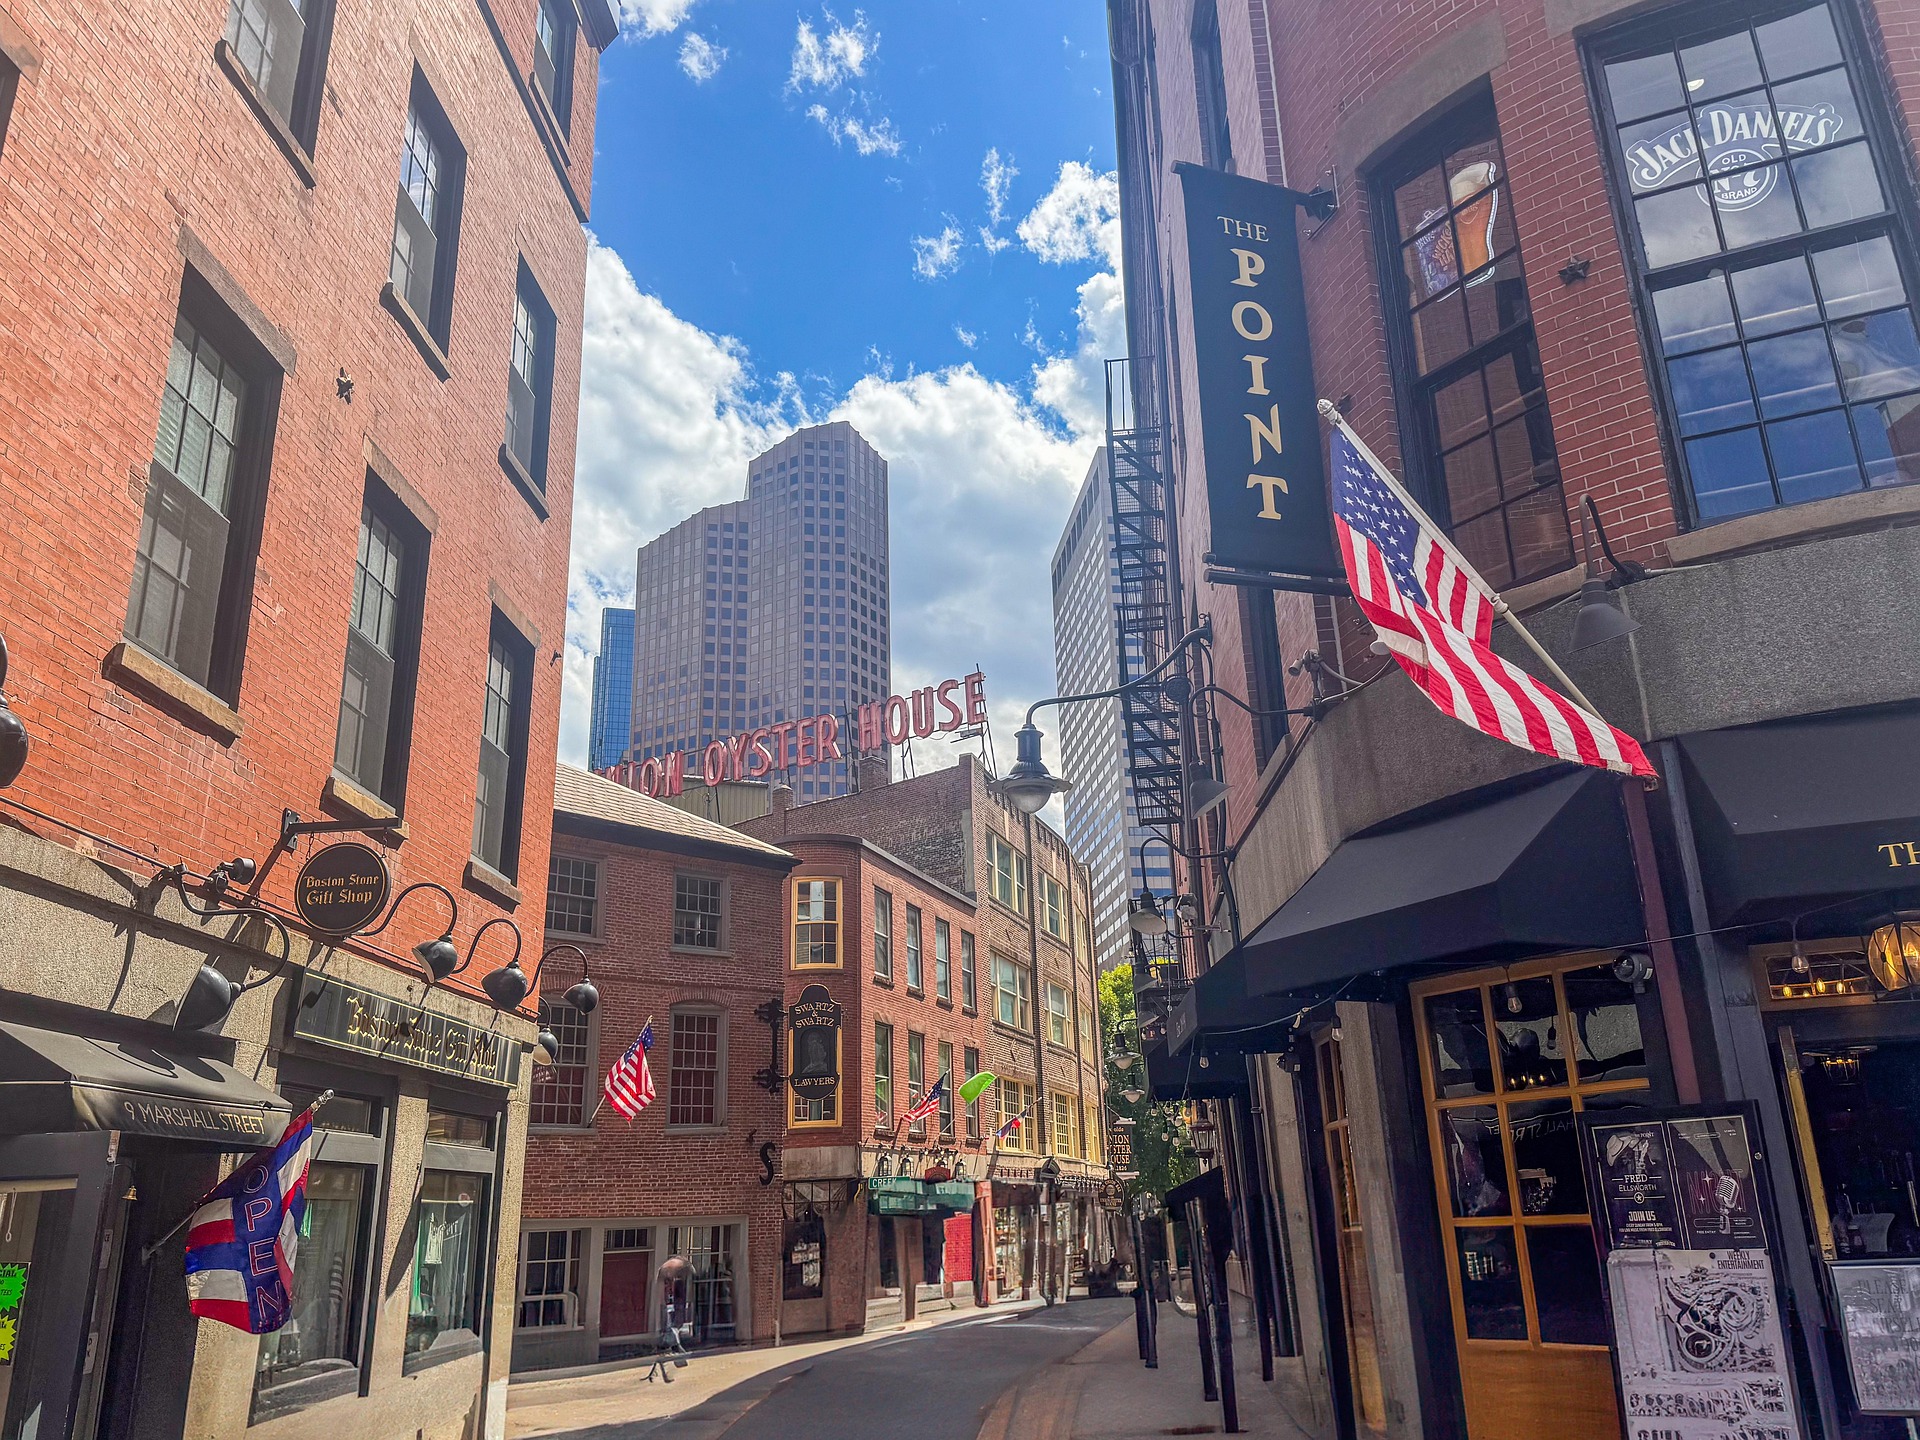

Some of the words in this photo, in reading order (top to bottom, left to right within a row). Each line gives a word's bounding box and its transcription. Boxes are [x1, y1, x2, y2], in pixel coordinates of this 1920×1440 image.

[1634, 124, 1711, 180] JACK
[1709, 108, 1834, 147] DANIEL'S
[1721, 153, 1747, 165] OLD
[1721, 187, 1758, 200] BRAND
[1217, 215, 1269, 242] THE
[1229, 248, 1288, 521] POINT
[703, 713, 843, 788] OYSTER
[857, 672, 988, 753] HOUSE
[303, 875, 345, 888] Boston
[349, 873, 379, 886] Stone
[306, 890, 333, 906] Gift
[338, 888, 372, 905] Shop
[794, 1001, 835, 1015] SWARTZ
[812, 1010, 818, 1018] &
[795, 1016, 834, 1028] SWARTZ
[794, 1076, 836, 1087] LAWYERS
[124, 1101, 136, 1120] 9
[138, 1102, 220, 1130] MARSHALL
[218, 1112, 266, 1135] STREET
[1111, 1155, 1131, 1164] OUSE
[1624, 1173, 1648, 1183] FRED
[1618, 1184, 1657, 1192] ELLSWORTH
[1628, 1211, 1646, 1221] JOIN
[1645, 1210, 1657, 1221] US
[243, 1164, 283, 1323] OPEN
[1726, 1250, 1750, 1260] WEEKLY
[1717, 1259, 1765, 1270] ENTERTAINMENT
